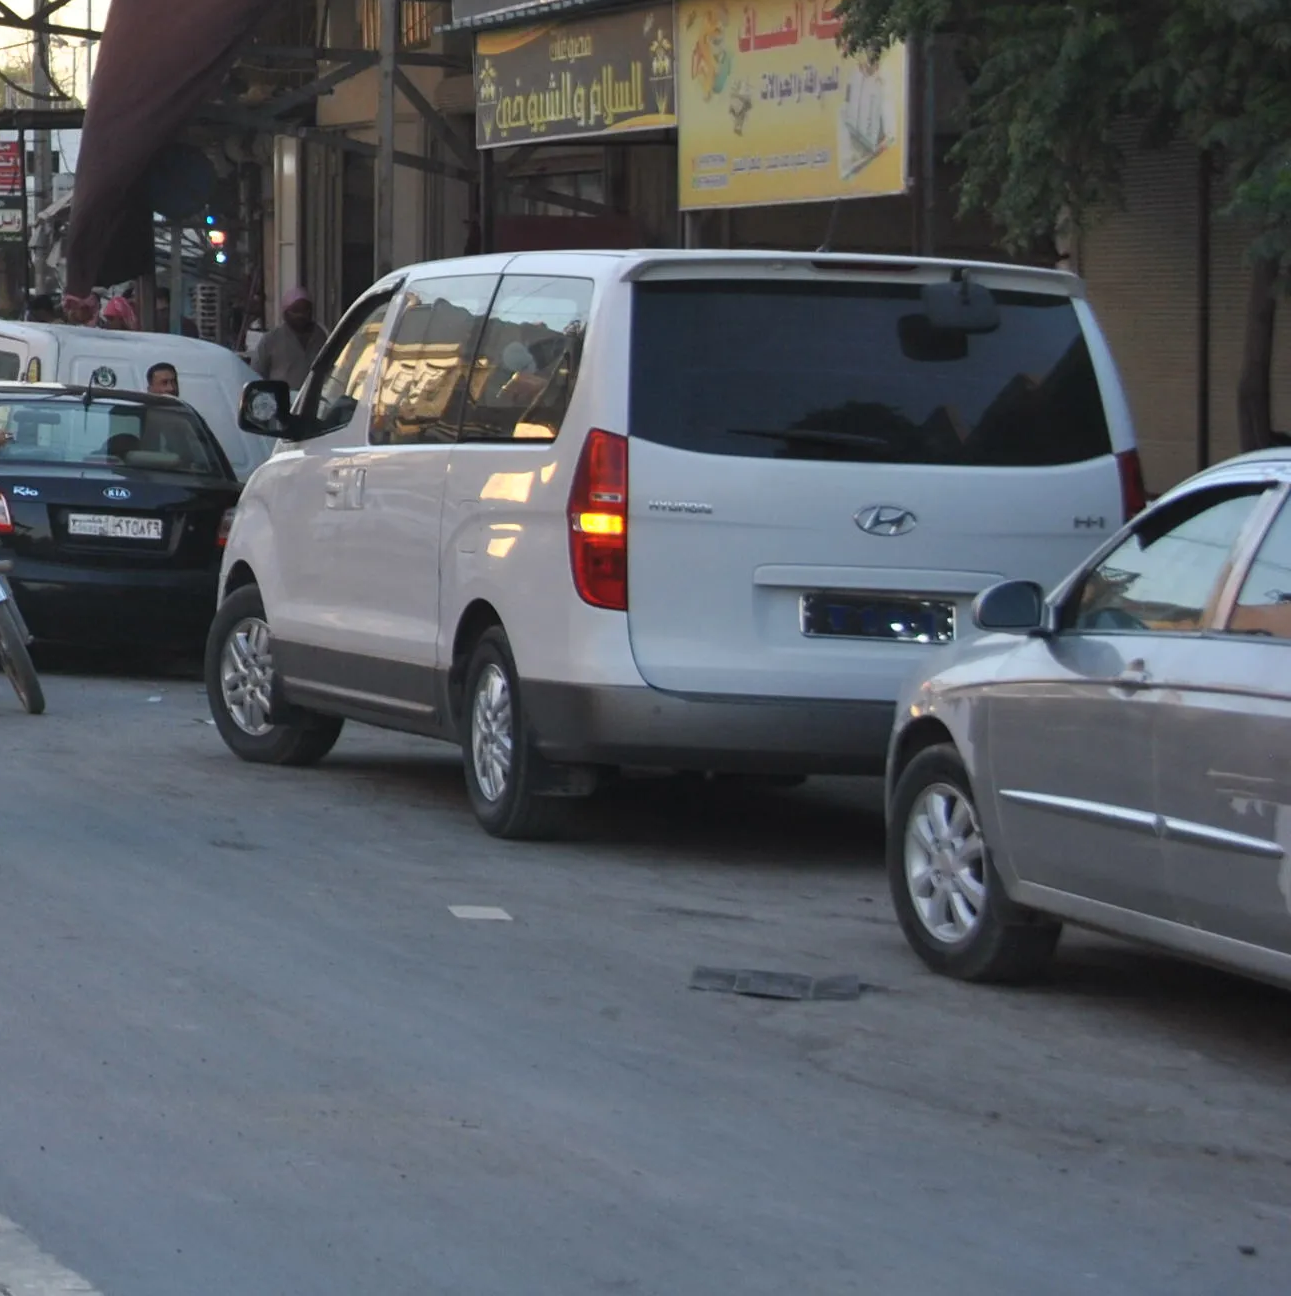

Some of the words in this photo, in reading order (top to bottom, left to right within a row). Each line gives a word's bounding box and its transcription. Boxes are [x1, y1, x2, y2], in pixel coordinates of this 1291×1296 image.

[12, 485, 39, 497] Rio
[107, 487, 128, 498] KIA
[648, 500, 713, 515] HYUNDAI
